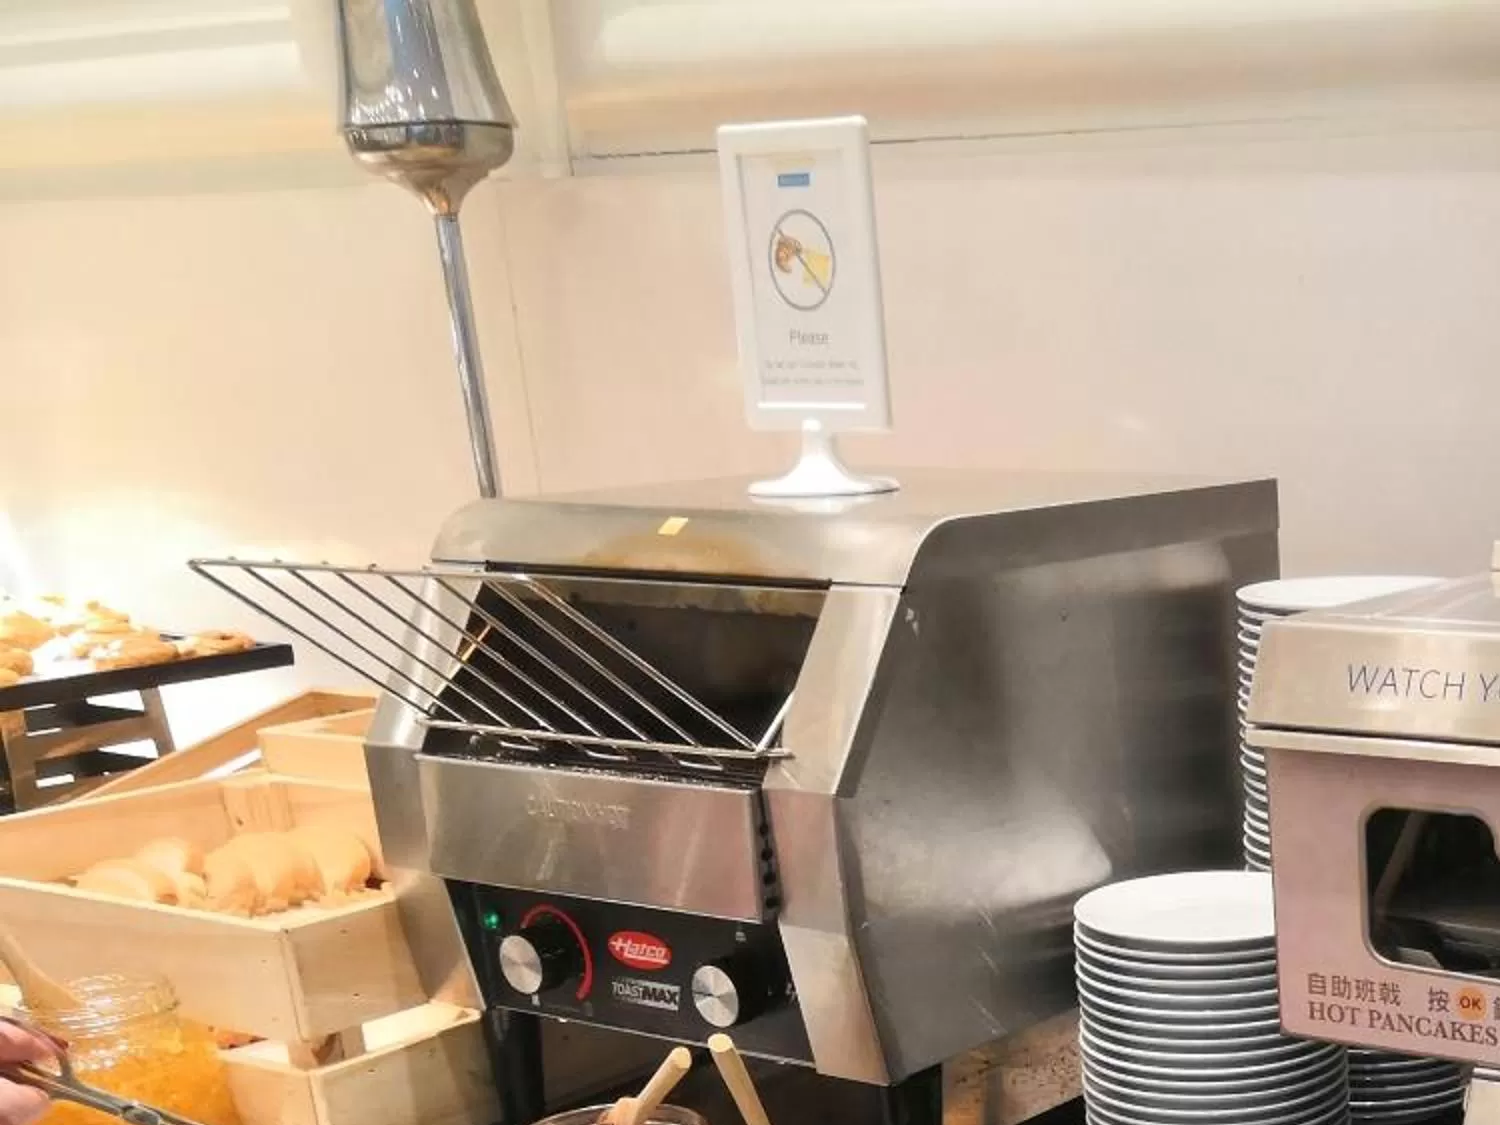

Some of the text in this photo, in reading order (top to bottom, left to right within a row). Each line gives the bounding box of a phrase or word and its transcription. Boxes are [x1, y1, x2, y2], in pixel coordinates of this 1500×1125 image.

[1346, 662, 1466, 702] WATCH
[608, 937, 670, 962] Hatco
[1428, 985, 1450, 1013] 按
[1459, 995, 1482, 1011] OK
[1308, 1000, 1361, 1026] HOT
[1367, 1008, 1499, 1047] PANCAKES
